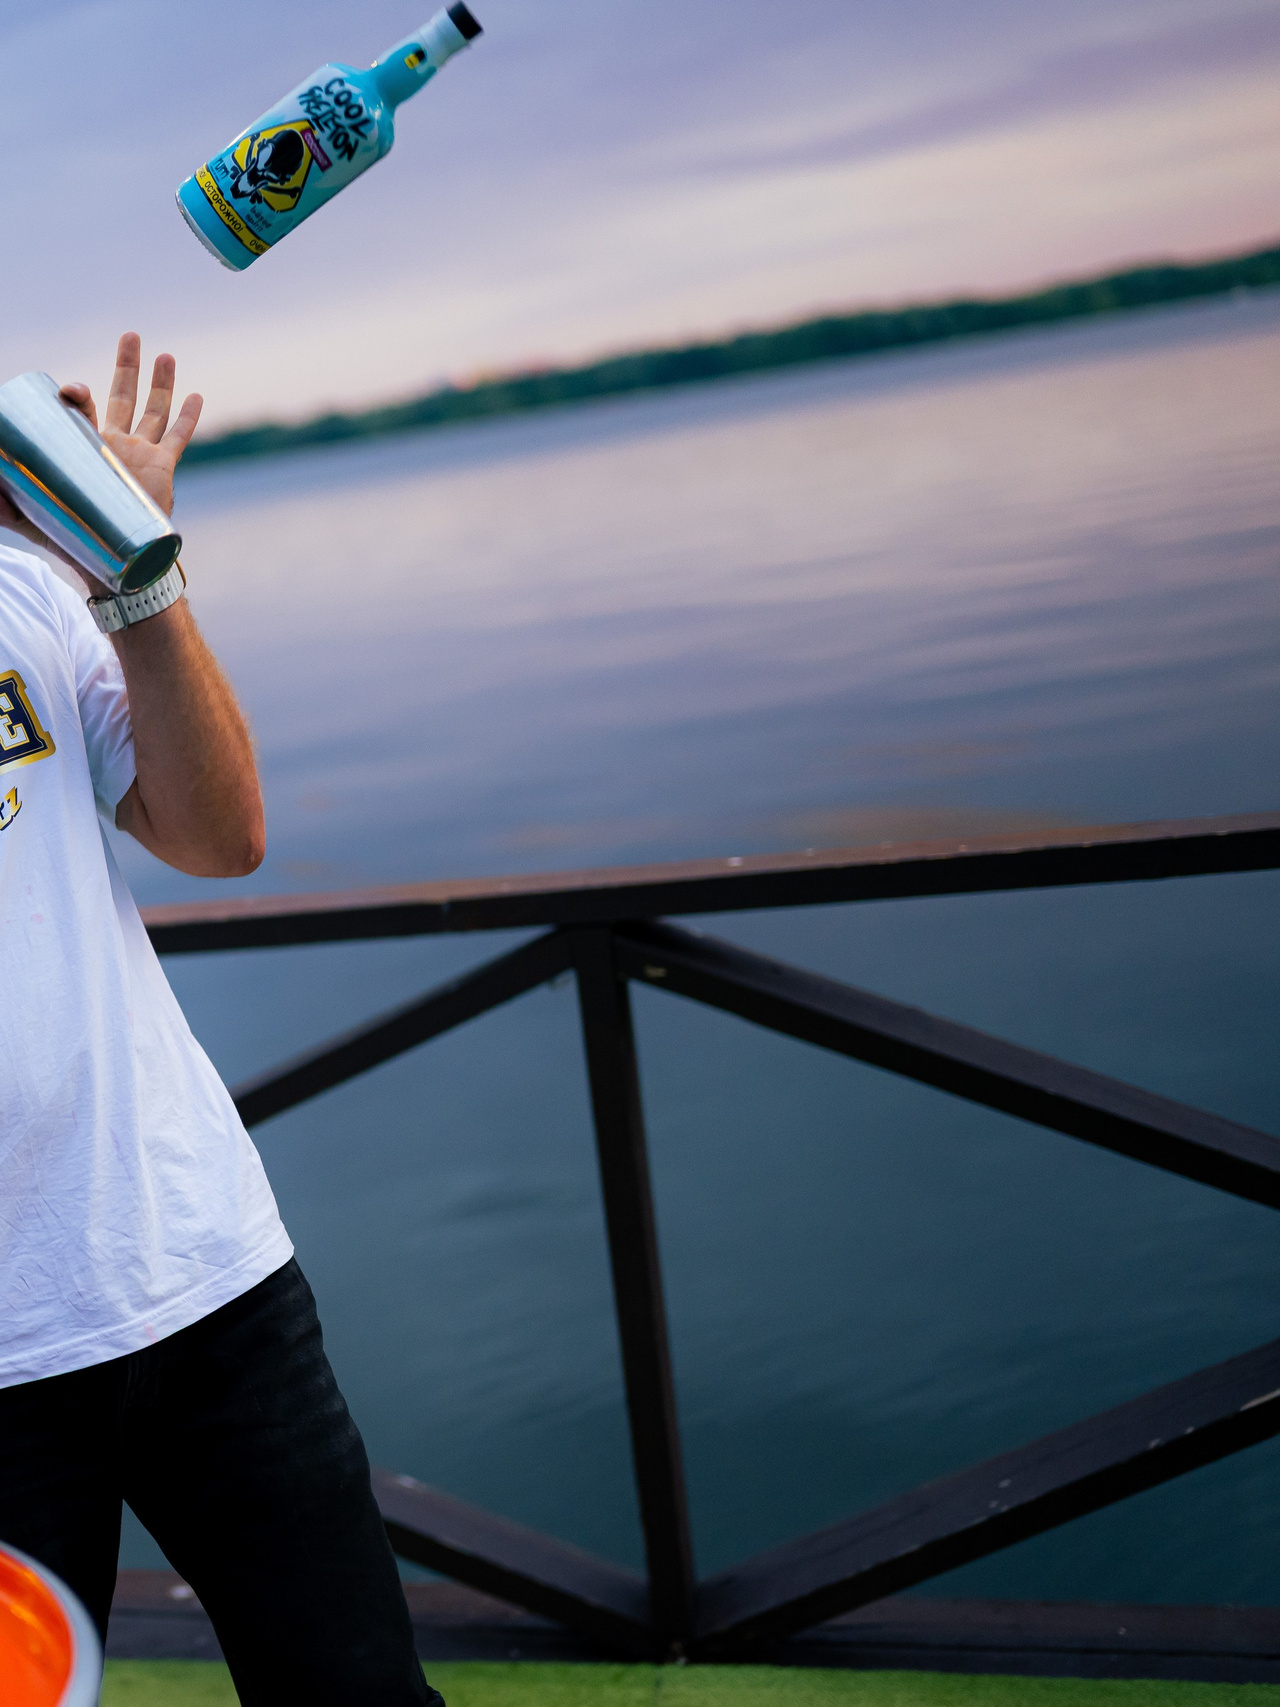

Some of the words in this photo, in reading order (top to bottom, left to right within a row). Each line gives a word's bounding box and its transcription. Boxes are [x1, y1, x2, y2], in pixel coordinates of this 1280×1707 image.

[298, 85, 360, 163] SKELETON
[324, 77, 370, 140] COOL
[214, 157, 230, 179] rum
[204, 180, 244, 233] ОСТОРОЖНО!
